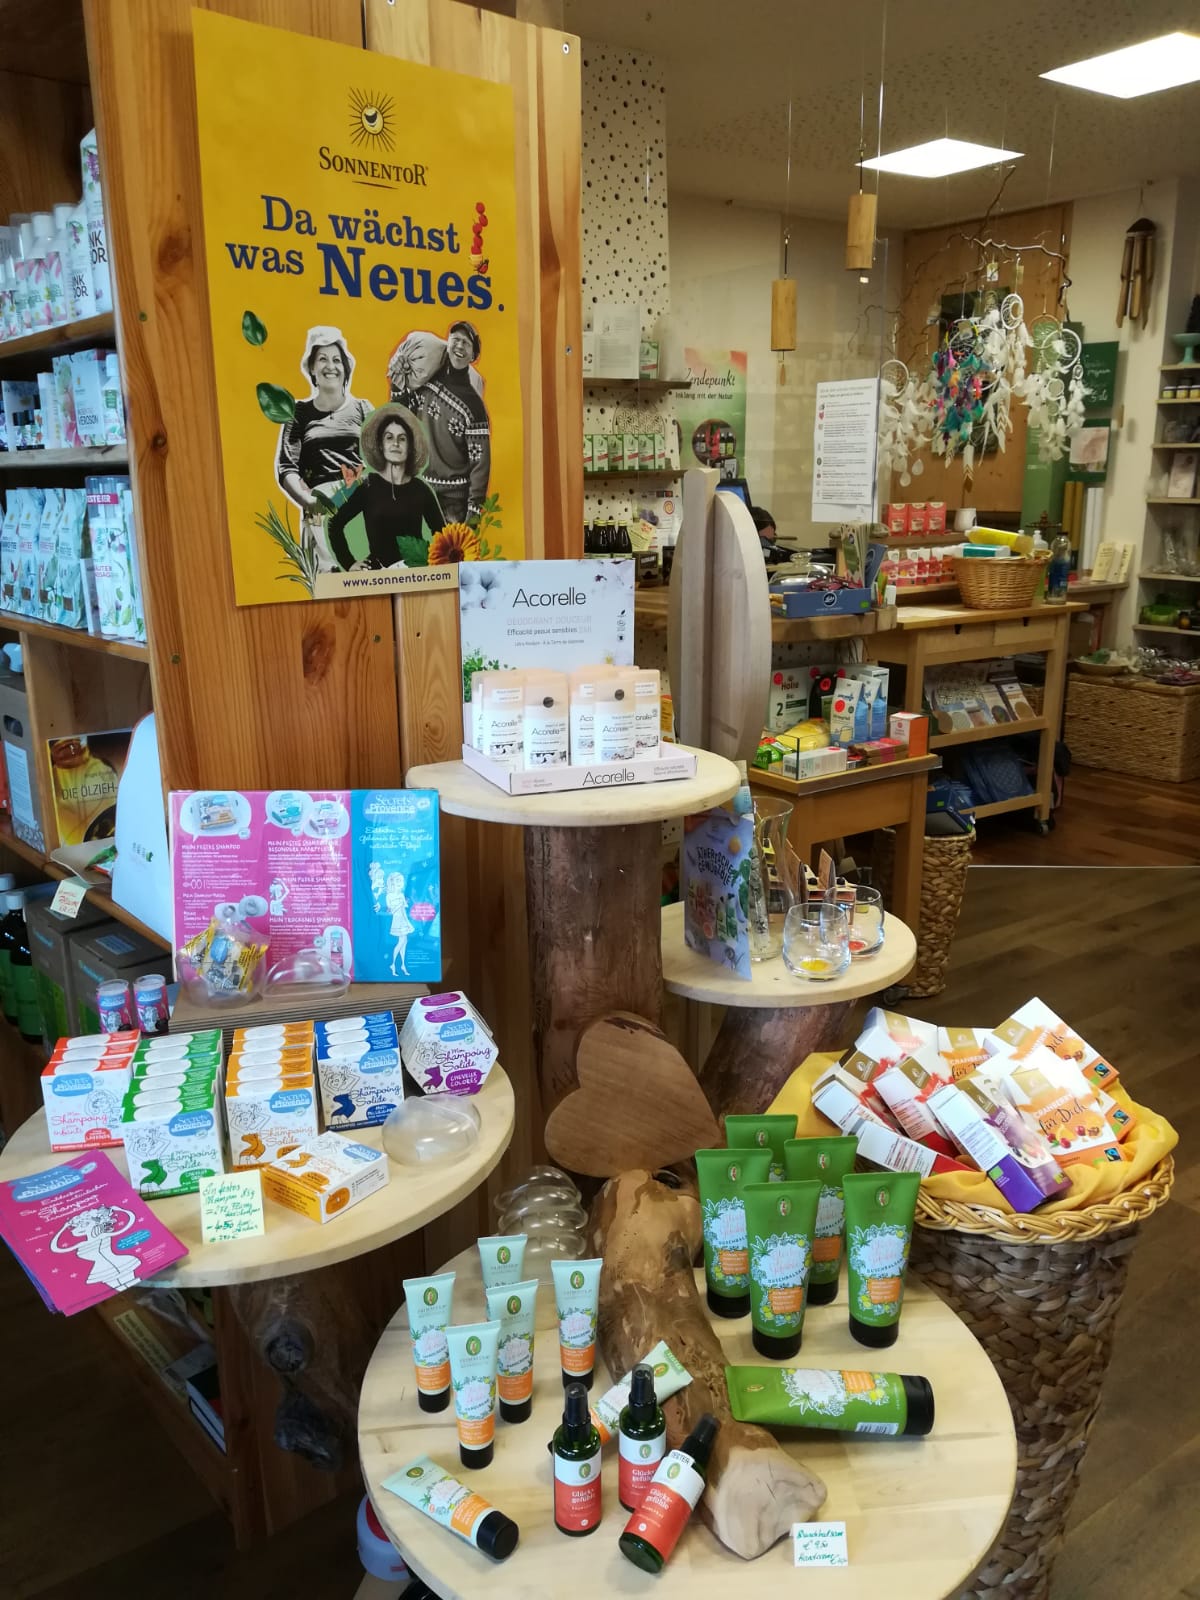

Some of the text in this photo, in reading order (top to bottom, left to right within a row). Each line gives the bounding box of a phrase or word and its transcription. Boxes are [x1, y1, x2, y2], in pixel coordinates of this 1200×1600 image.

[260, 194, 460, 253] Da wächst
[225, 242, 505, 312] was Neues.
[342, 572, 451, 588] www.sonnentor.com
[512, 587, 587, 608] Acorelle
[776, 703, 783, 716] 2
[582, 768, 635, 786] Acorelle
[62, 788, 78, 801] DIE
[435, 1048, 491, 1065] Shampoing
[443, 1060, 477, 1072] Solide
[349, 1085, 401, 1100] Shampoing
[355, 1096, 386, 1107] Solide
[1058, 1099, 1087, 1123] Dich
[51, 1113, 108, 1126] Shampoing
[1038, 1113, 1058, 1135] für
[259, 1126, 314, 1138] Shampoing
[262, 1136, 298, 1148] Solide
[160, 1148, 217, 1165] Shampoing
[167, 1160, 201, 1173] Solide
